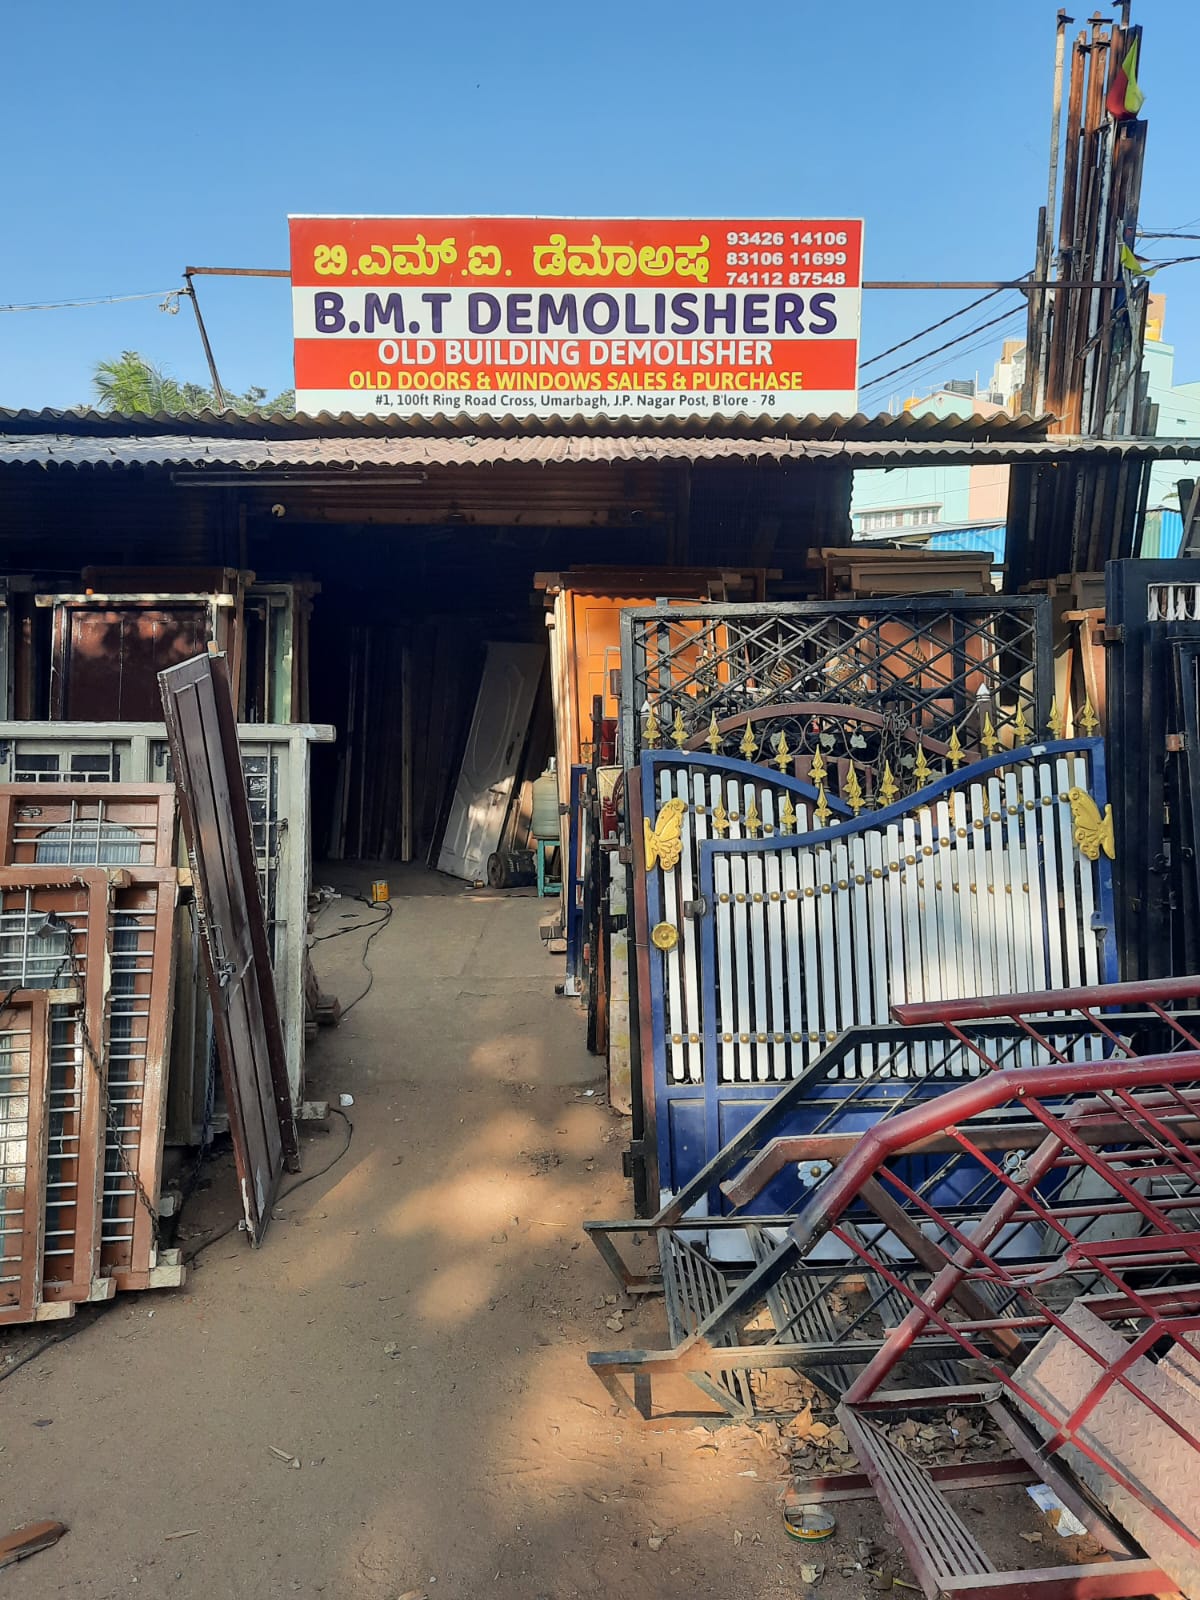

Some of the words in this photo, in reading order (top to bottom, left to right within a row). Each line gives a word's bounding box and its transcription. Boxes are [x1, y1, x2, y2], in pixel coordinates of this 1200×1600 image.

[726, 231, 784, 246] 93426
[790, 231, 848, 246] 14106
[726, 251, 784, 266] 83106
[790, 251, 847, 266] 11699
[726, 271, 783, 286] 74112
[788, 271, 846, 286] 87548
[314, 291, 452, 335] B.M.T
[467, 291, 838, 335] DEMOLISHERS
[377, 339, 437, 365] OLD
[444, 339, 580, 366] BUILDING
[589, 340, 773, 366] DEMOLISHER
[349, 371, 392, 390] OLD
[397, 371, 471, 391] DOORS
[475, 371, 492, 391] &
[494, 371, 602, 391] WINDOWS
[606, 371, 667, 391] SALES
[671, 371, 688, 391] &
[691, 371, 803, 391] PURCHASE
[375, 394, 394, 407] #1,
[396, 393, 430, 406] 100ft
[433, 393, 461, 408] Ring
[464, 393, 497, 407] Road
[500, 394, 537, 408] Cross,
[540, 394, 611, 409] Umarbagh,
[613, 394, 634, 407] J.P.
[637, 394, 675, 409] Nagar
[678, 394, 709, 408] Post,
[760, 394, 776, 407] 78
